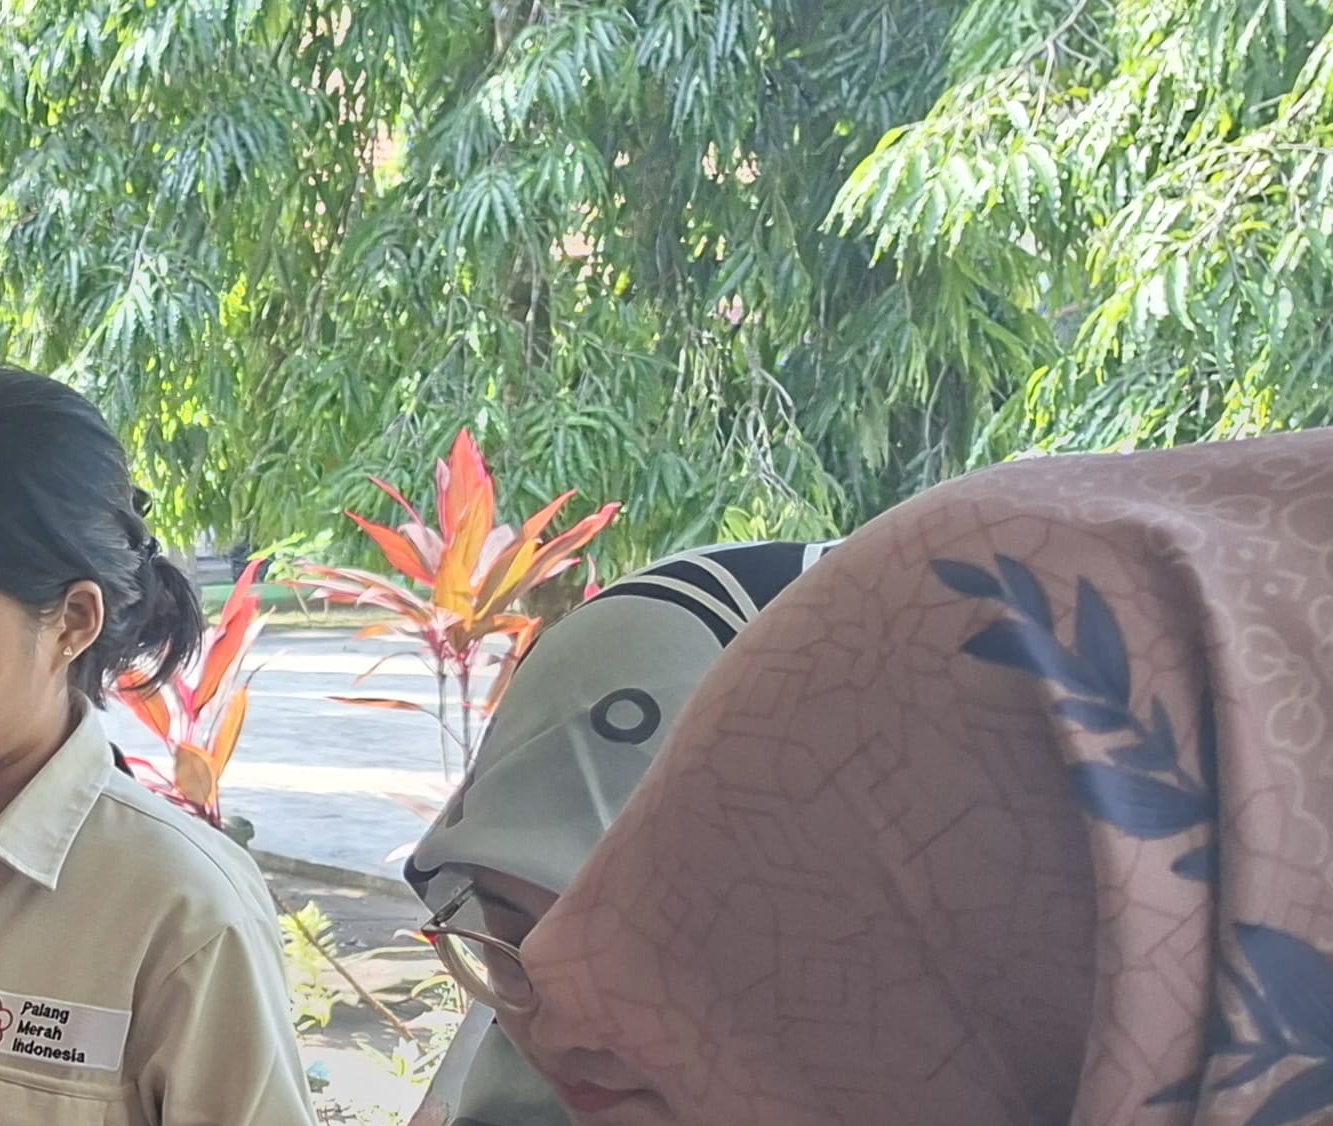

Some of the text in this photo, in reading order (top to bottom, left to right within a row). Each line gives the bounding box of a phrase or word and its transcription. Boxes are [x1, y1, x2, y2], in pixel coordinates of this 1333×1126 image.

[20, 1000, 70, 1024] Palang
[16, 1019, 63, 1041] Merah
[12, 1038, 85, 1063] Indonesia
